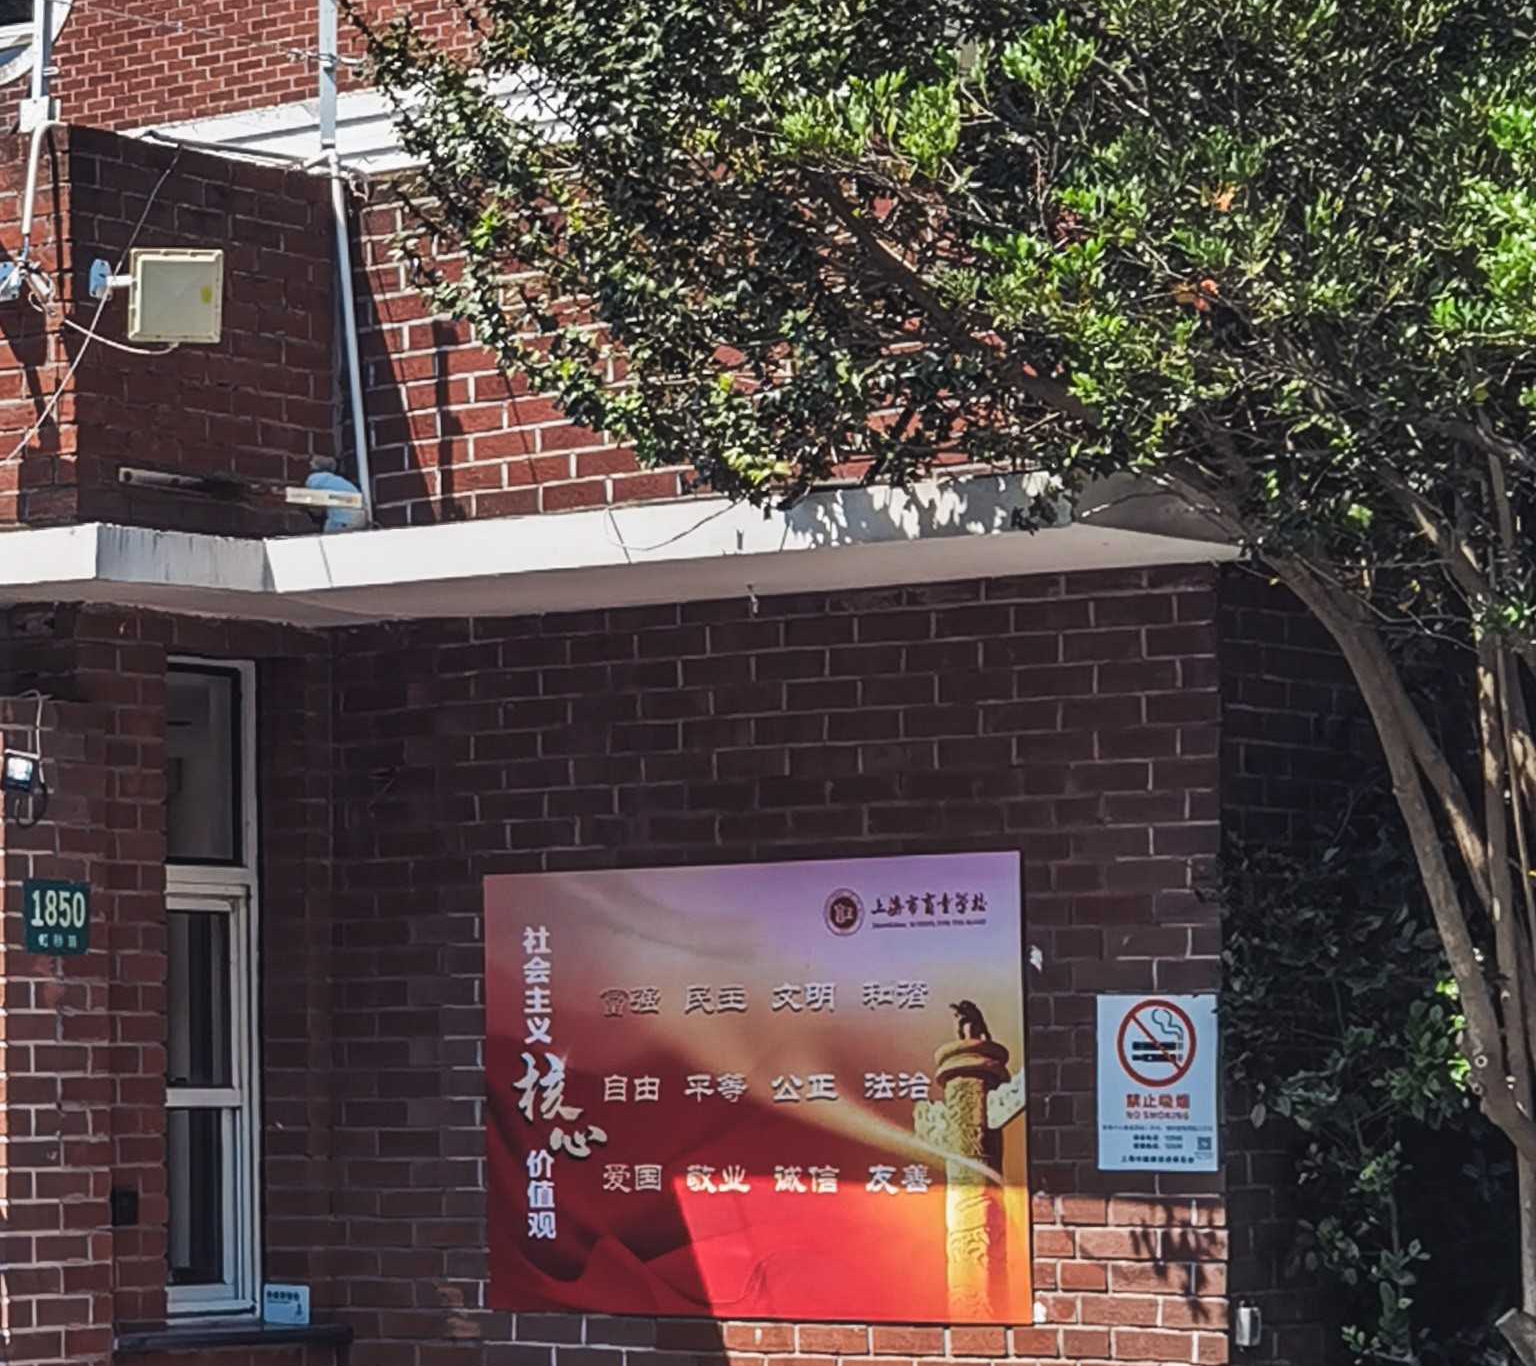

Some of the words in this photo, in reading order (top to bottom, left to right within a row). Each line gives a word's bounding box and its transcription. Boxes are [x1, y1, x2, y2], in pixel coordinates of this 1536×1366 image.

[30, 889, 86, 929] 1850
[600, 986, 662, 1018] 富强
[684, 984, 749, 1015] 民主
[771, 982, 837, 1013] 文明
[862, 980, 929, 1011] 和谐
[603, 1073, 661, 1103] 自由
[684, 1072, 749, 1104] 平等
[771, 1072, 839, 1103] 公正
[863, 1071, 932, 1101] 法治
[602, 1163, 663, 1193] 爱国
[685, 1163, 751, 1194] 敬业
[773, 1163, 840, 1194] 诚信
[865, 1163, 933, 1194] 友善
